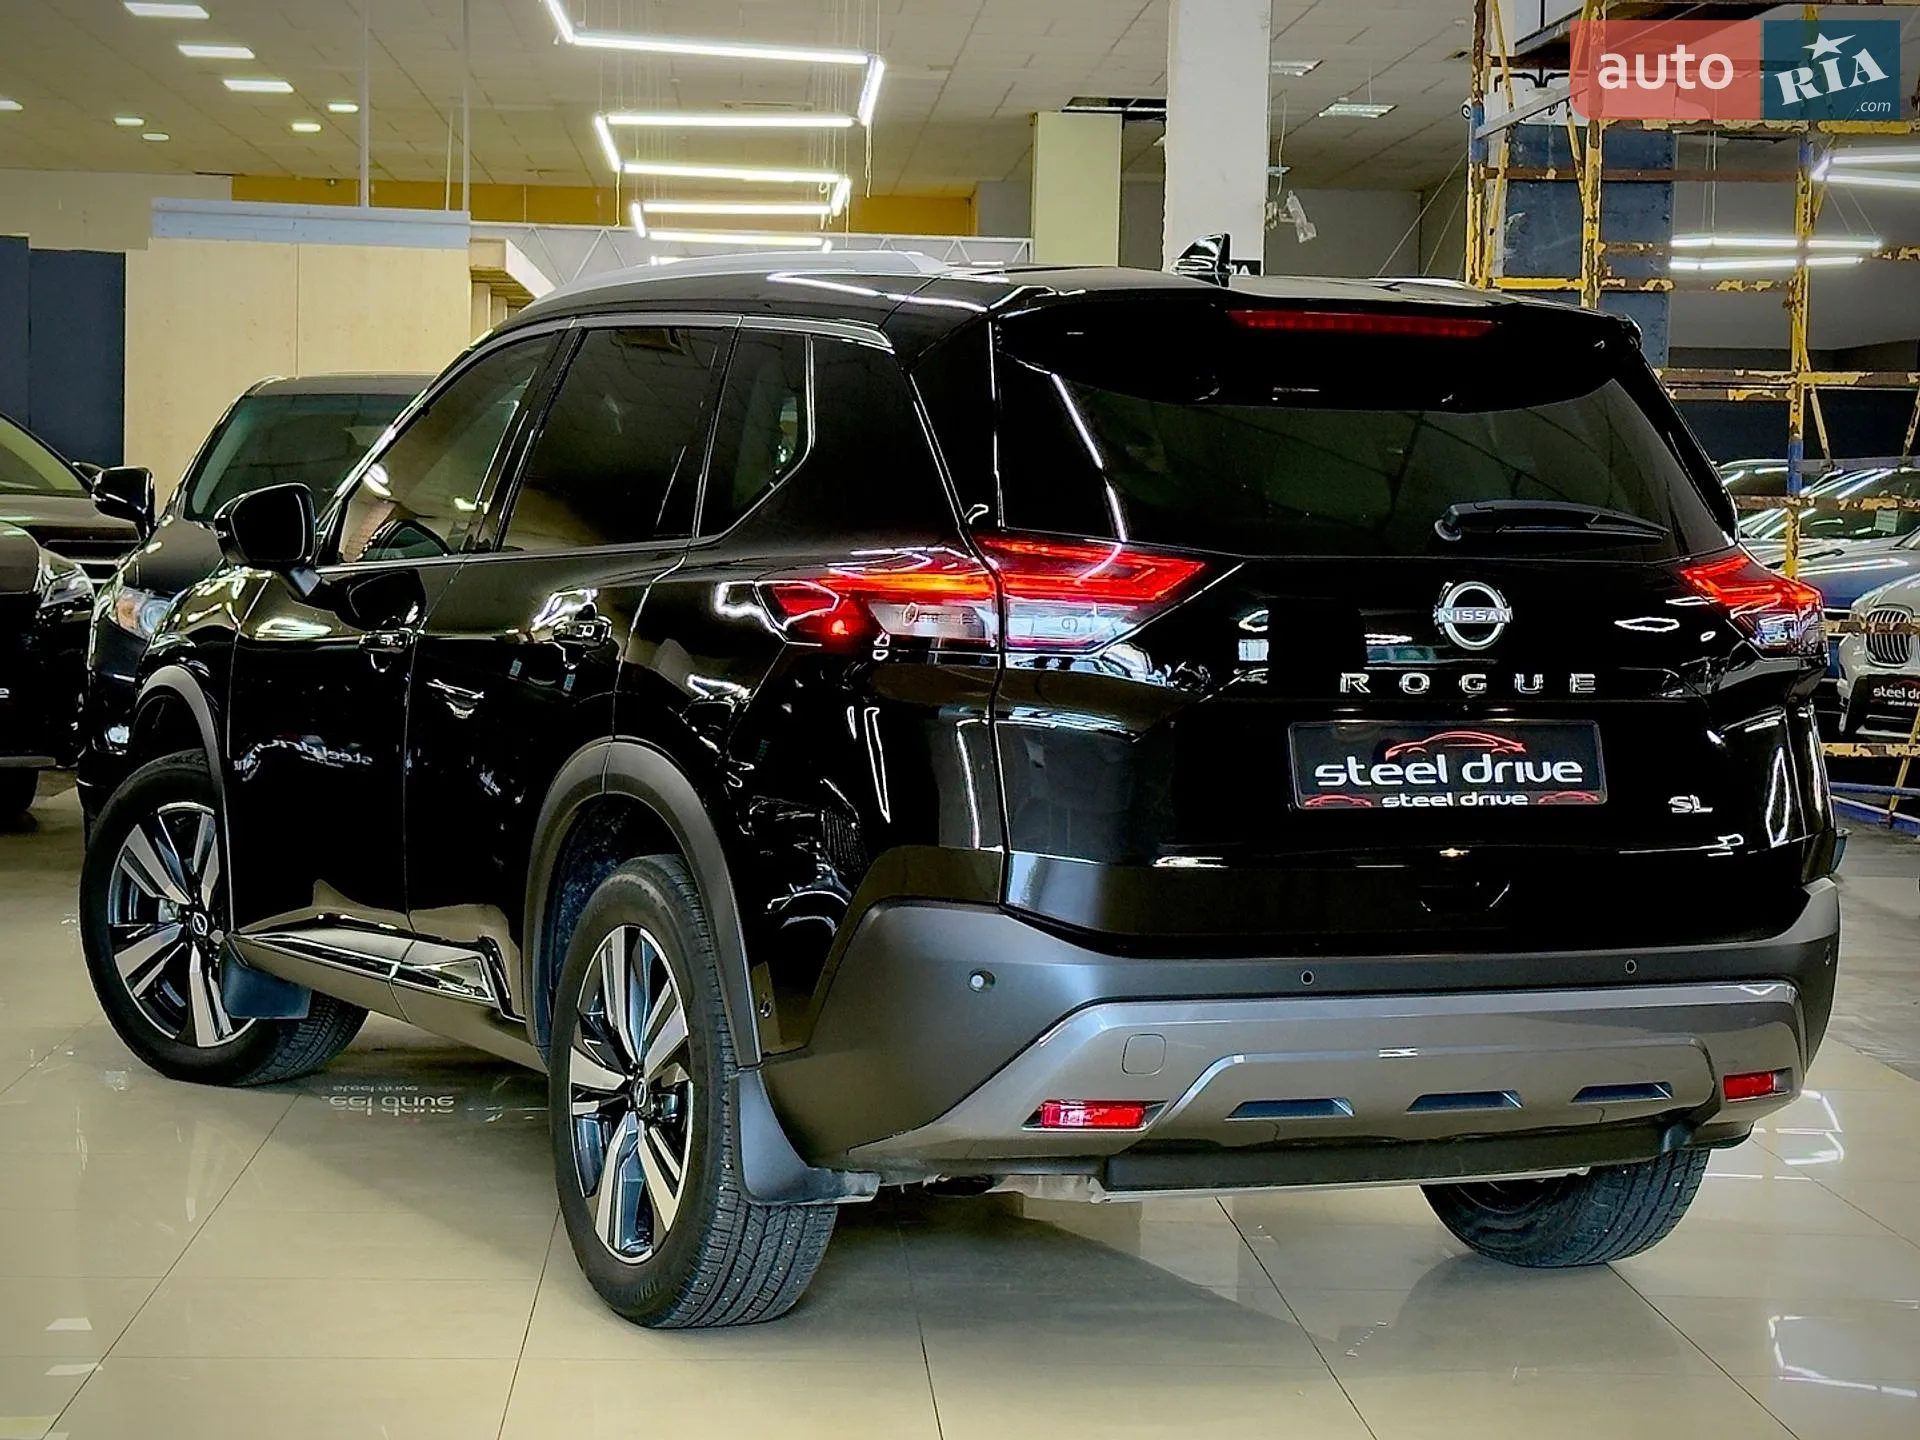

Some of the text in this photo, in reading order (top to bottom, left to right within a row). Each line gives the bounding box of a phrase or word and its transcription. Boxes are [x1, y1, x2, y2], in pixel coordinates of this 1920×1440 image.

[1440, 610, 1510, 622] NISSAN
[1339, 672, 1597, 694] ROGUE
[1873, 685, 1906, 698] steel
[1314, 752, 1584, 786] steel drive
[1381, 791, 1529, 808] steel drive
[1668, 795, 1713, 814] SL
